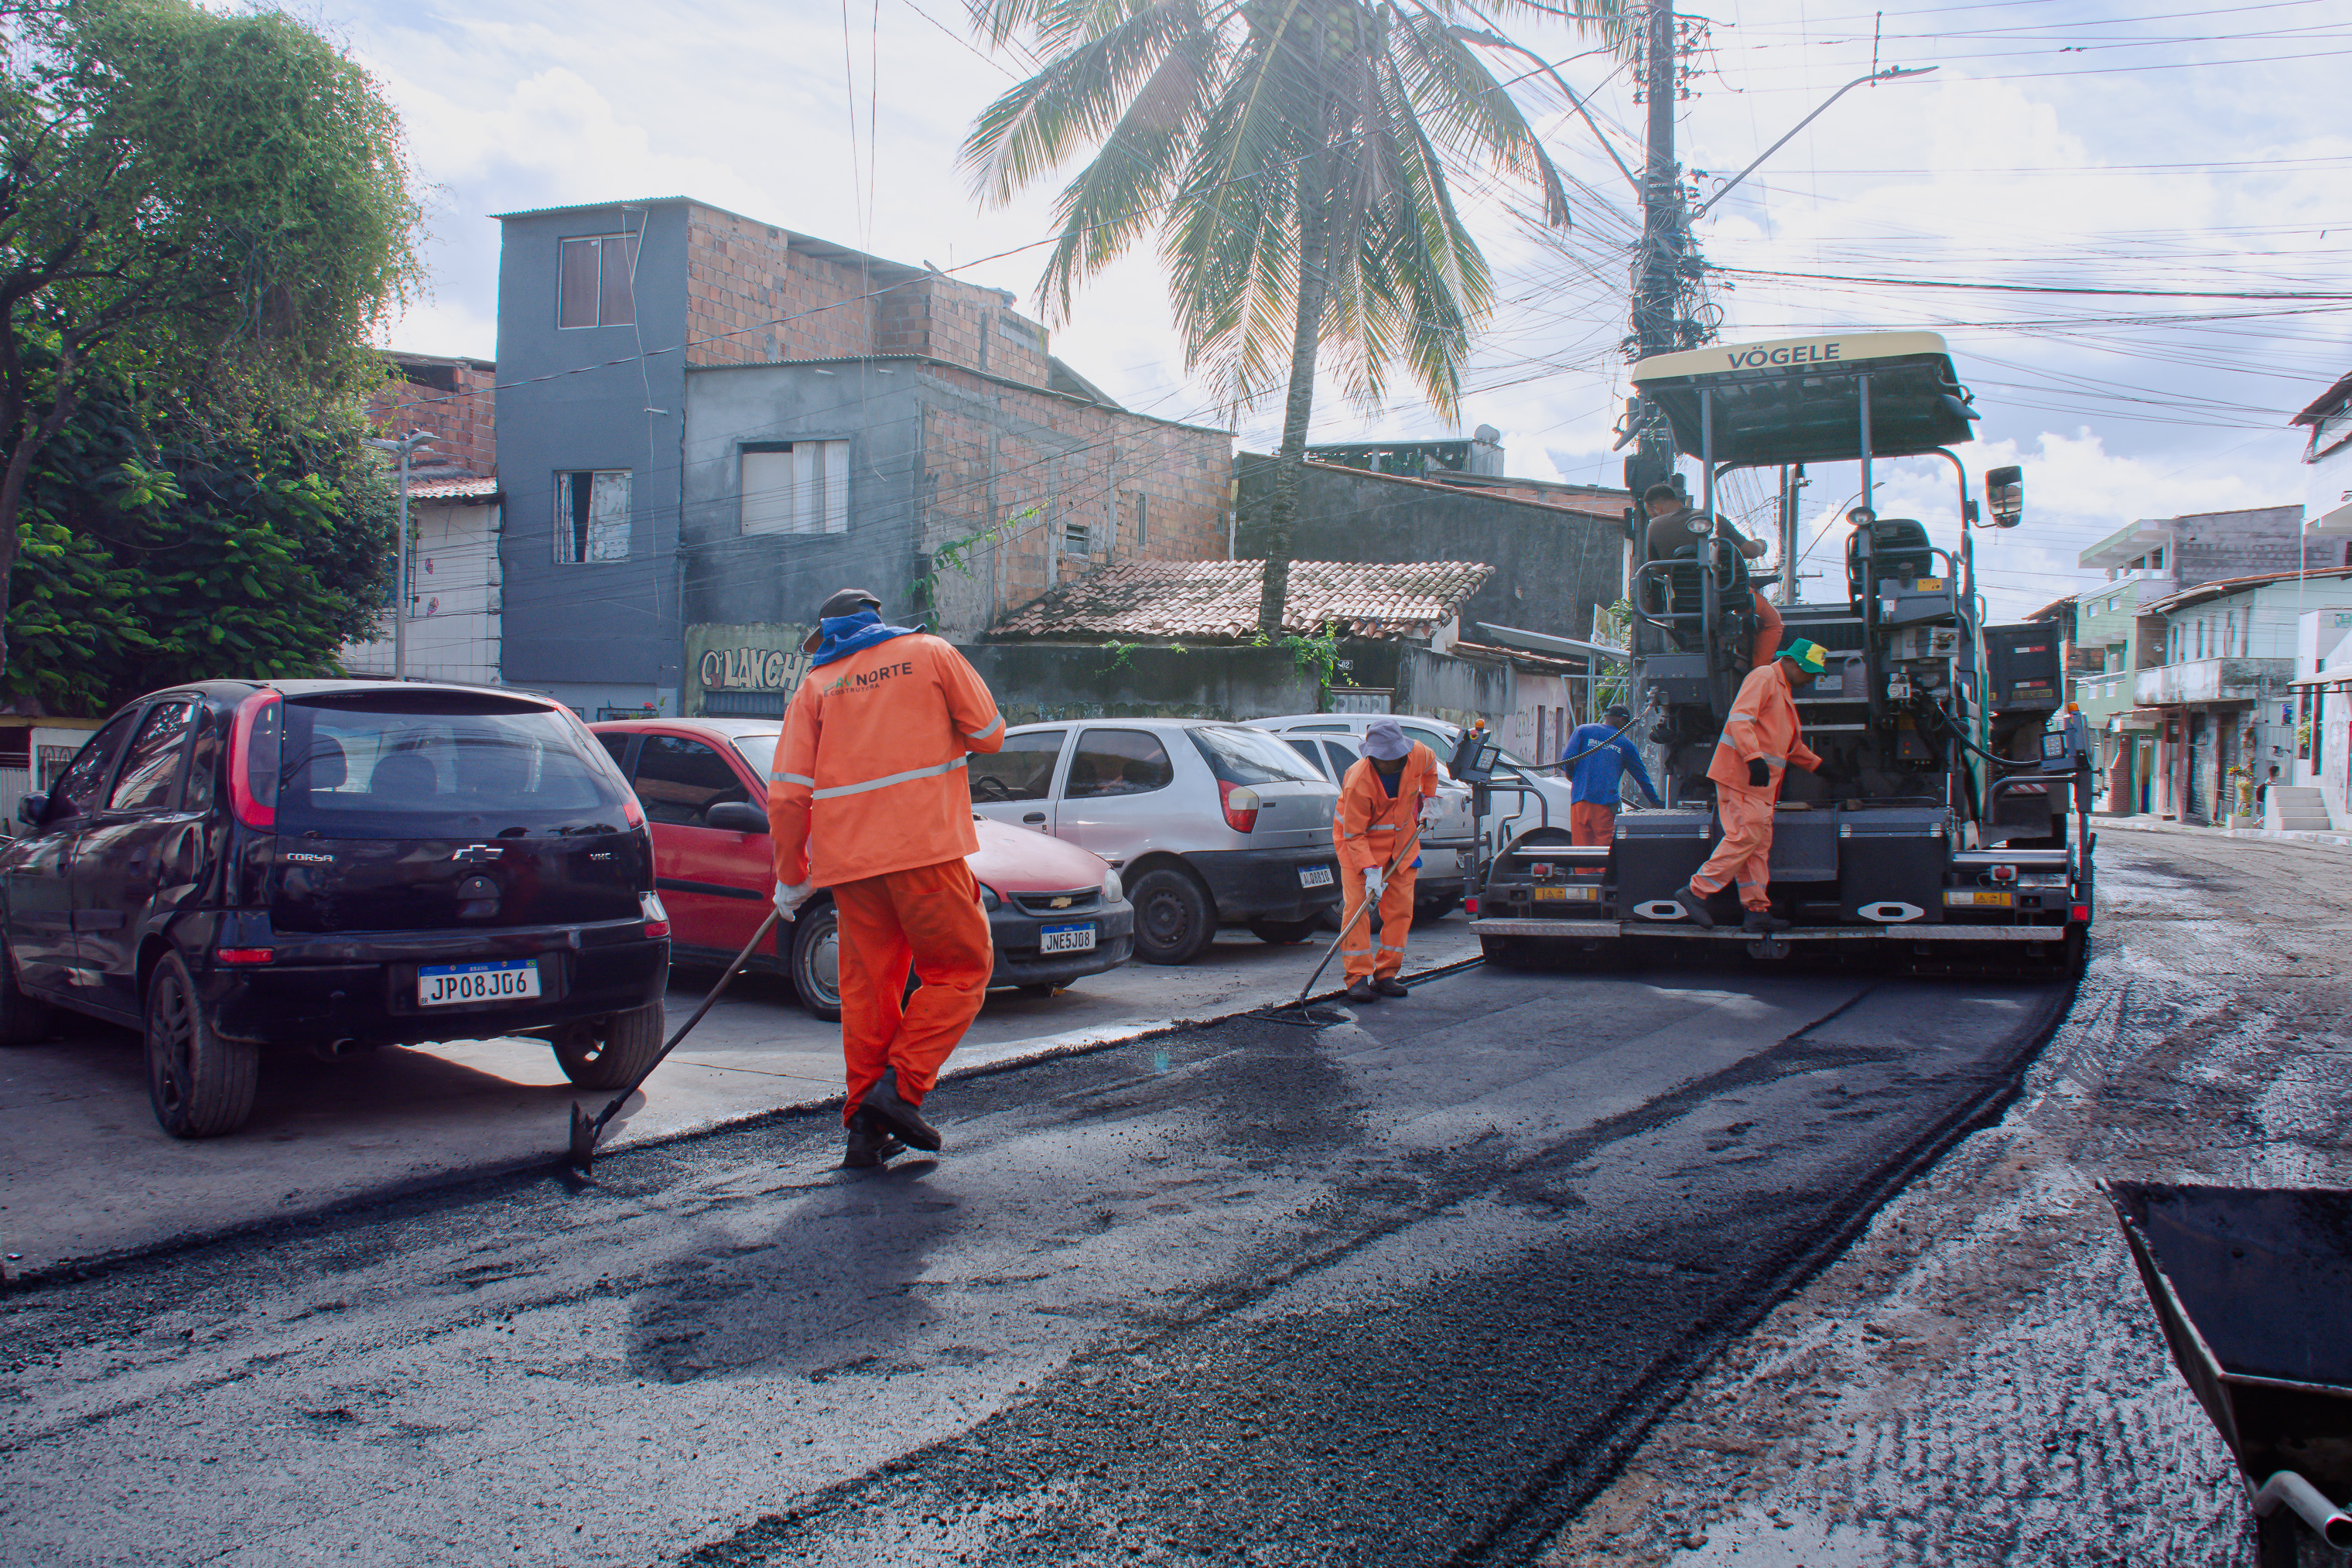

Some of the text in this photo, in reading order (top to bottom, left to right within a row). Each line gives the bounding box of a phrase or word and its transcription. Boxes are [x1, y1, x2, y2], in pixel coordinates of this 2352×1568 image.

[1727, 343, 1840, 369] VÖGELE
[285, 852, 333, 862] CORSA
[1047, 931, 1090, 951] JNE5J08
